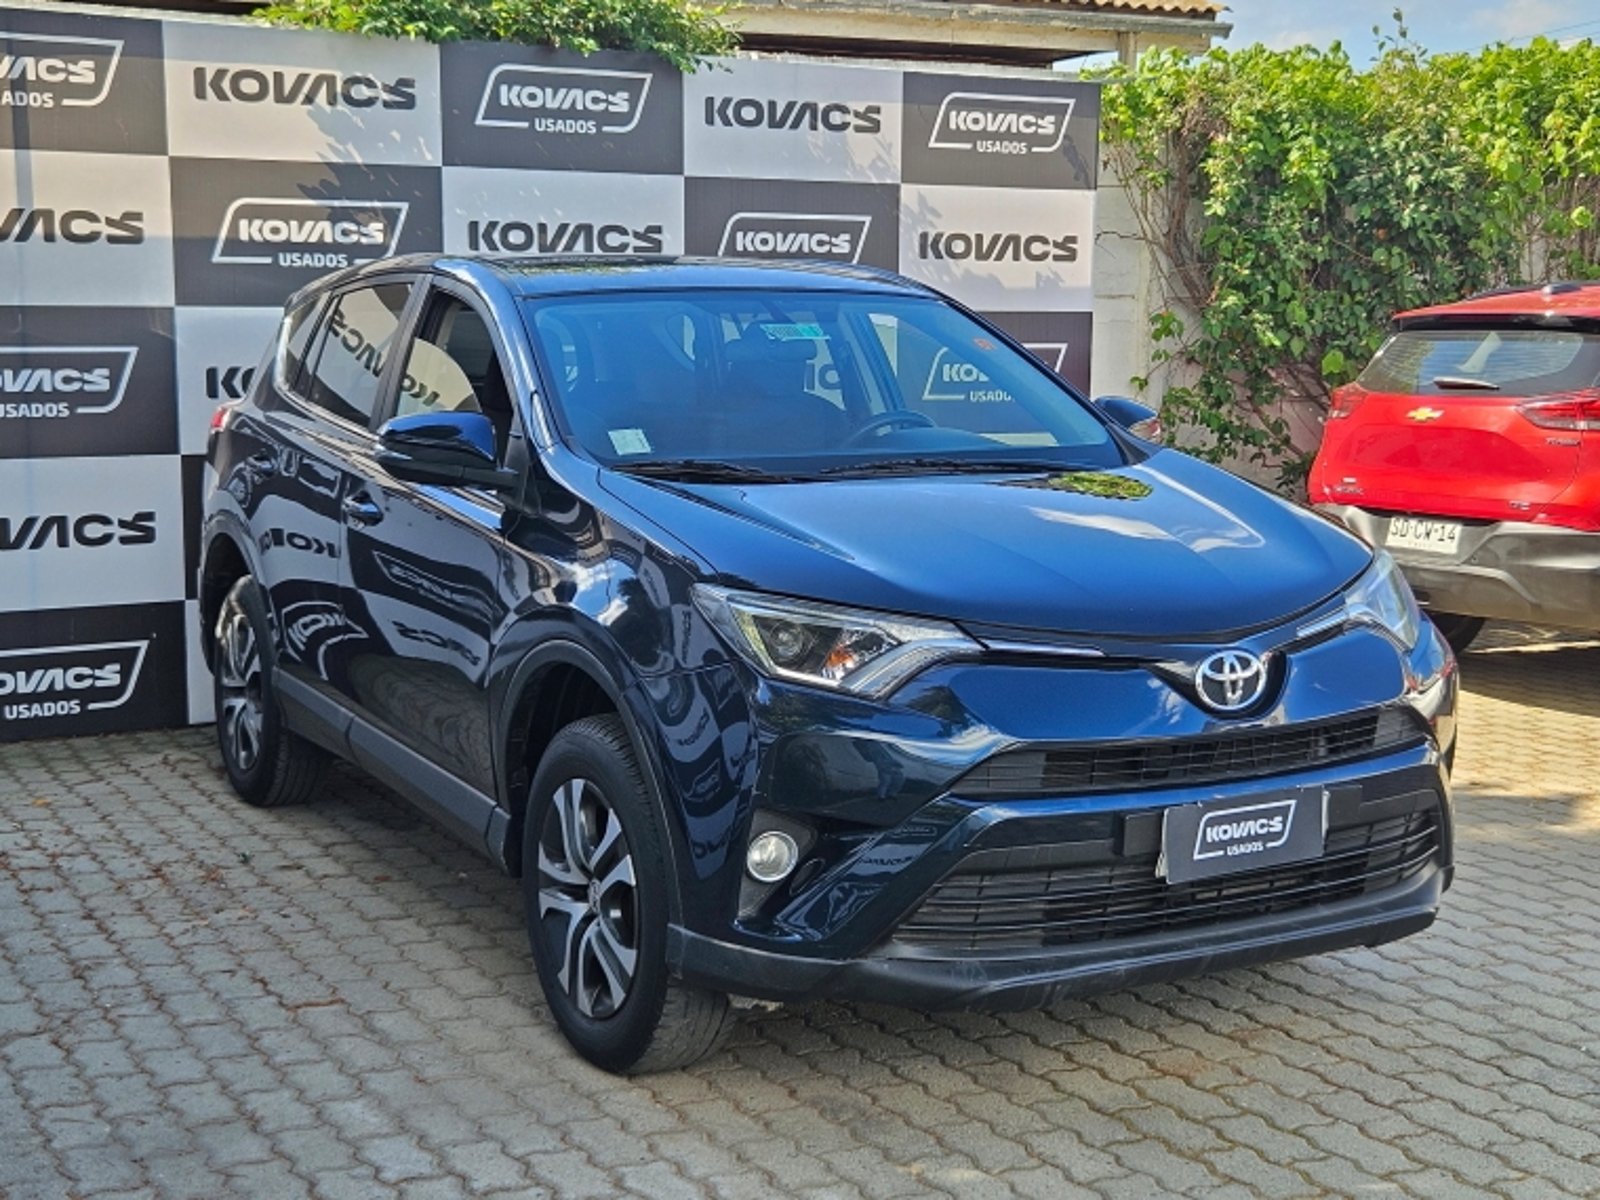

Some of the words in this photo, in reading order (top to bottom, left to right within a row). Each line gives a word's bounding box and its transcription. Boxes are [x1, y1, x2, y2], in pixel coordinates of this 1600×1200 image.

[193, 67, 416, 110] KOVACS
[500, 84, 630, 113] KOVACS
[535, 118, 597, 134] USADOS
[704, 97, 881, 133] KOVACS
[948, 111, 1055, 135] KOVACS
[976, 140, 1028, 155] USADOS
[239, 218, 384, 245] KOVACS
[468, 220, 663, 254] KOVACS
[735, 231, 851, 254] KOVACS
[918, 231, 1079, 262] KOVACS
[278, 252, 349, 268] USADOS
[0, 368, 111, 392] VACS
[970, 389, 1015, 402] USAD
[4, 700, 81, 719] USADOS
[1205, 816, 1283, 842] KOVACS
[1226, 841, 1264, 856] USADOS
